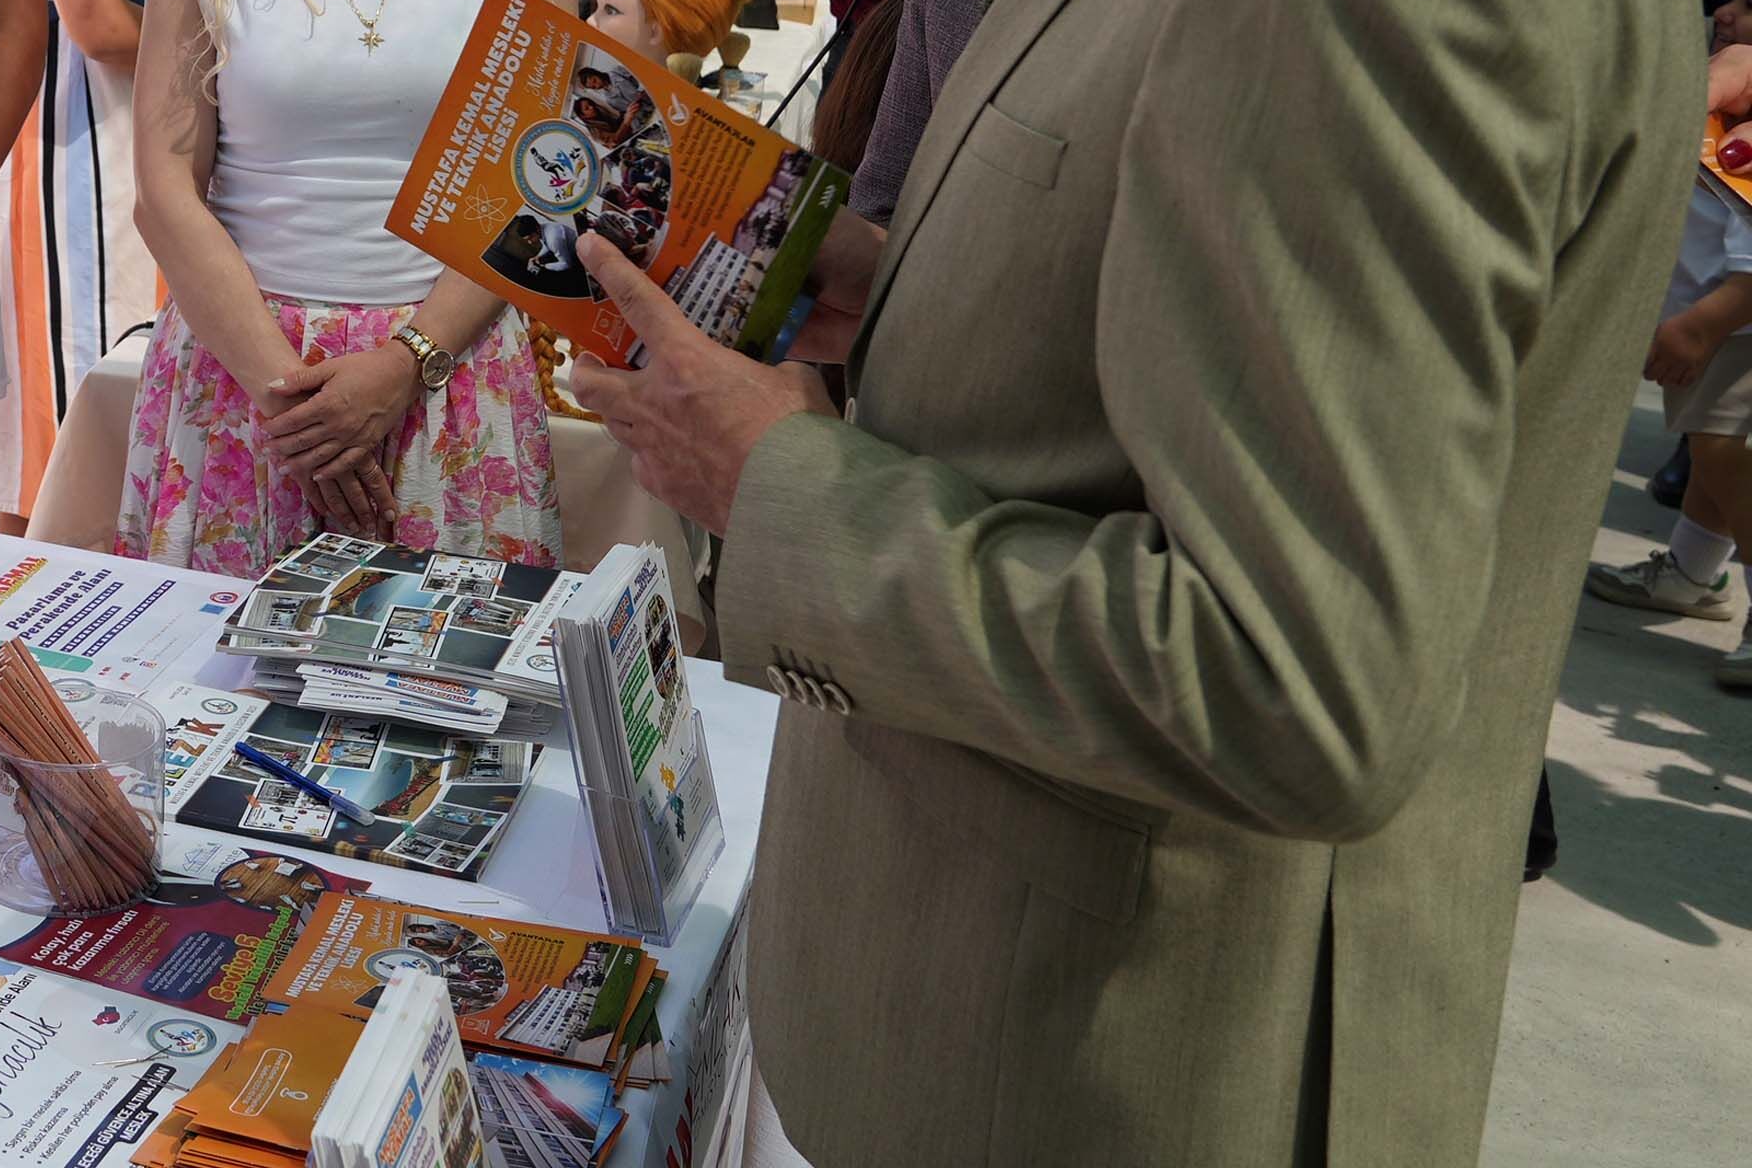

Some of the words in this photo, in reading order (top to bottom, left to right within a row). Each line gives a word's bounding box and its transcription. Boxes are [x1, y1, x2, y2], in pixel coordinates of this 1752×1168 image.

[433, 198, 457, 225] VE
[447, 128, 488, 198] TEKNİK
[480, 29, 533, 129] ANADOLU
[484, 107, 520, 165] LİSESİ
[410, 147, 461, 235] MUSTAFA
[450, 81, 492, 147] KEMAL
[6, 580, 72, 630] Pazarlama
[68, 568, 86, 584] ve
[19, 592, 83, 641] Perakende
[83, 568, 113, 594] Alanı
[31, 933, 66, 962] Kolay,
[64, 917, 84, 936] hızlı
[52, 947, 74, 967] çok
[69, 930, 95, 953] para
[66, 936, 113, 972] kazanma
[106, 909, 139, 939] fırsatı
[8, 972, 38, 994] Alanı
[208, 948, 256, 1004] Seviye
[97, 1106, 133, 1146] GÜVENCE
[129, 1084, 155, 1114] ALTINA
[119, 1110, 152, 1142] MESLEK
